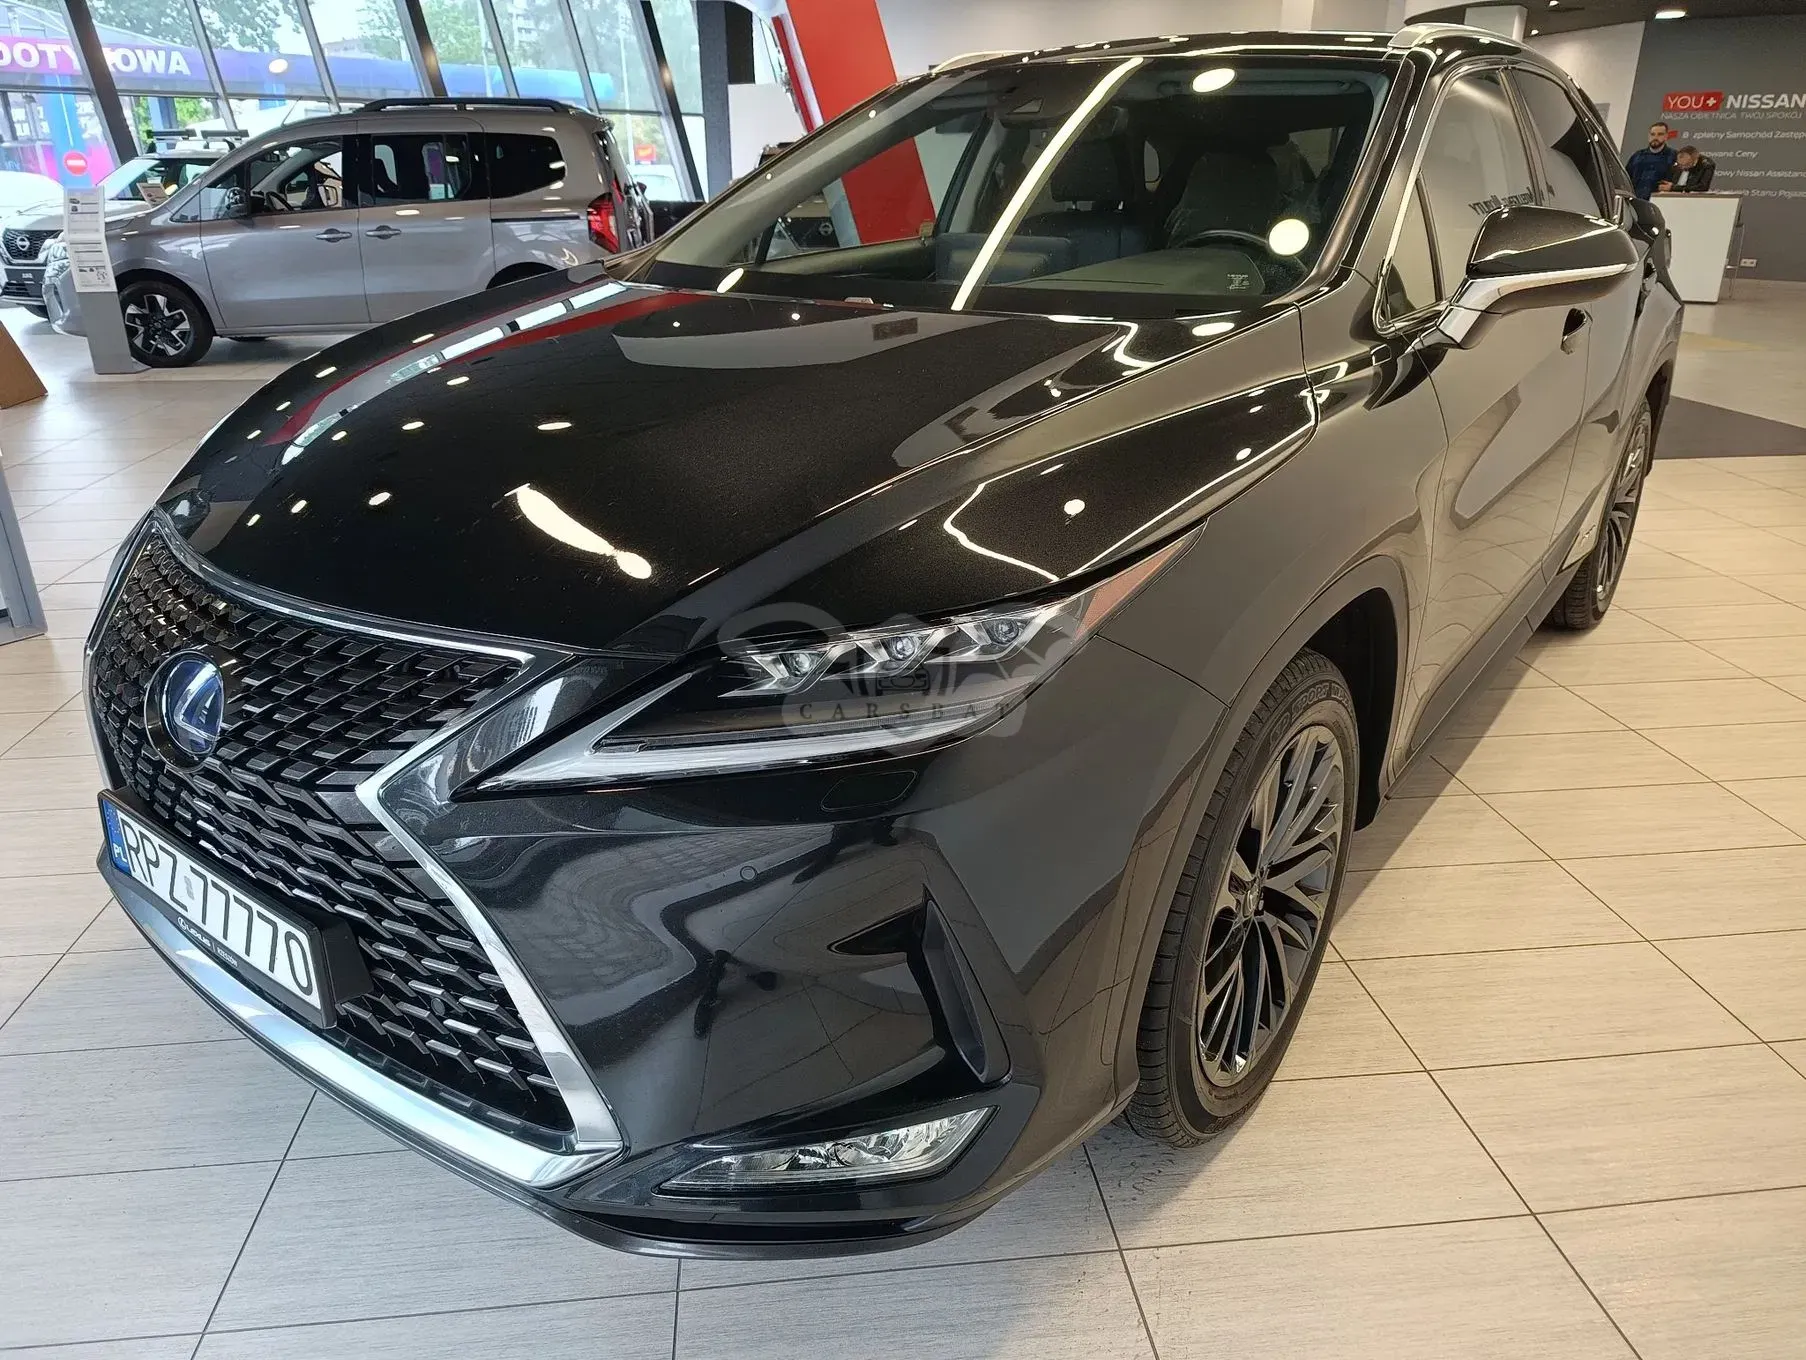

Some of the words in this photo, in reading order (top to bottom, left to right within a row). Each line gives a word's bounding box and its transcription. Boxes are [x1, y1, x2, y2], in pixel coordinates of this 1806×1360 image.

[1726, 94, 1806, 109] NISSAN
[112, 842, 127, 863] PL
[120, 816, 188, 912] RPZ
